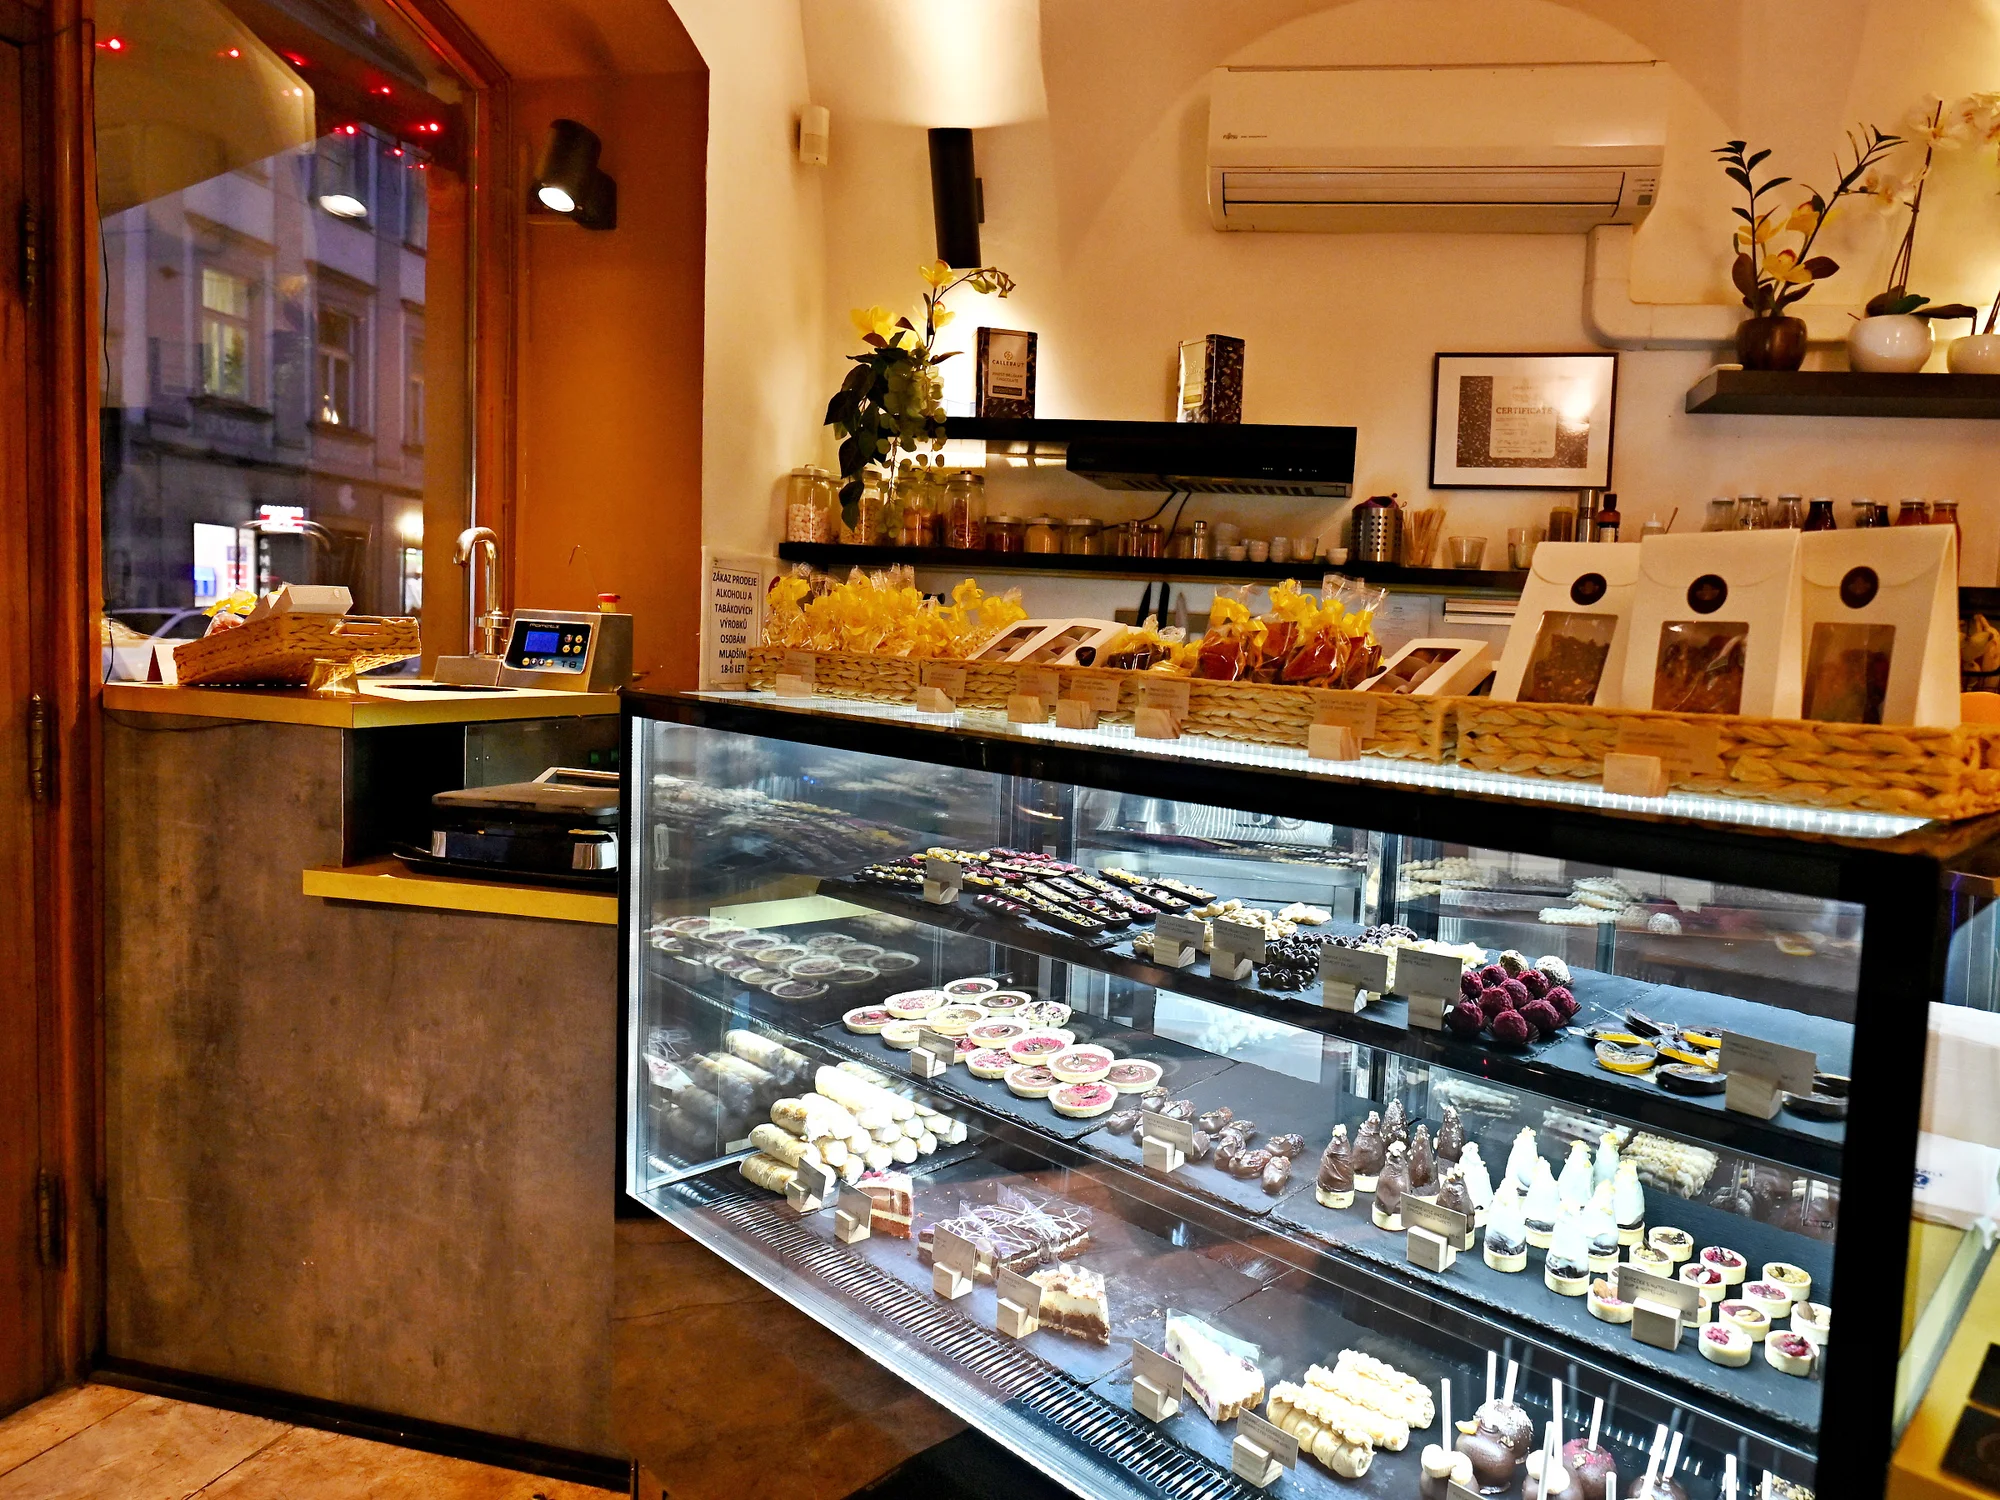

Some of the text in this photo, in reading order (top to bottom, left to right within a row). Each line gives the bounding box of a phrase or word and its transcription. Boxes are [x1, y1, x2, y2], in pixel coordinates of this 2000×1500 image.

[992, 360, 1024, 368] CALLEBAUT
[1495, 406, 1553, 415] CERTIFICATE
[712, 571, 757, 587] ZÁKAZ PRODEJE
[715, 588, 747, 600] ALKOHOLU
[714, 602, 753, 615] TABÁKOVÝCH
[719, 616, 748, 630] VÝROBKŮ
[720, 633, 746, 644] OSOBÁM
[719, 647, 747, 659] MLADŠÍM
[561, 660, 577, 668] T8
[734, 664, 745, 674] LET
